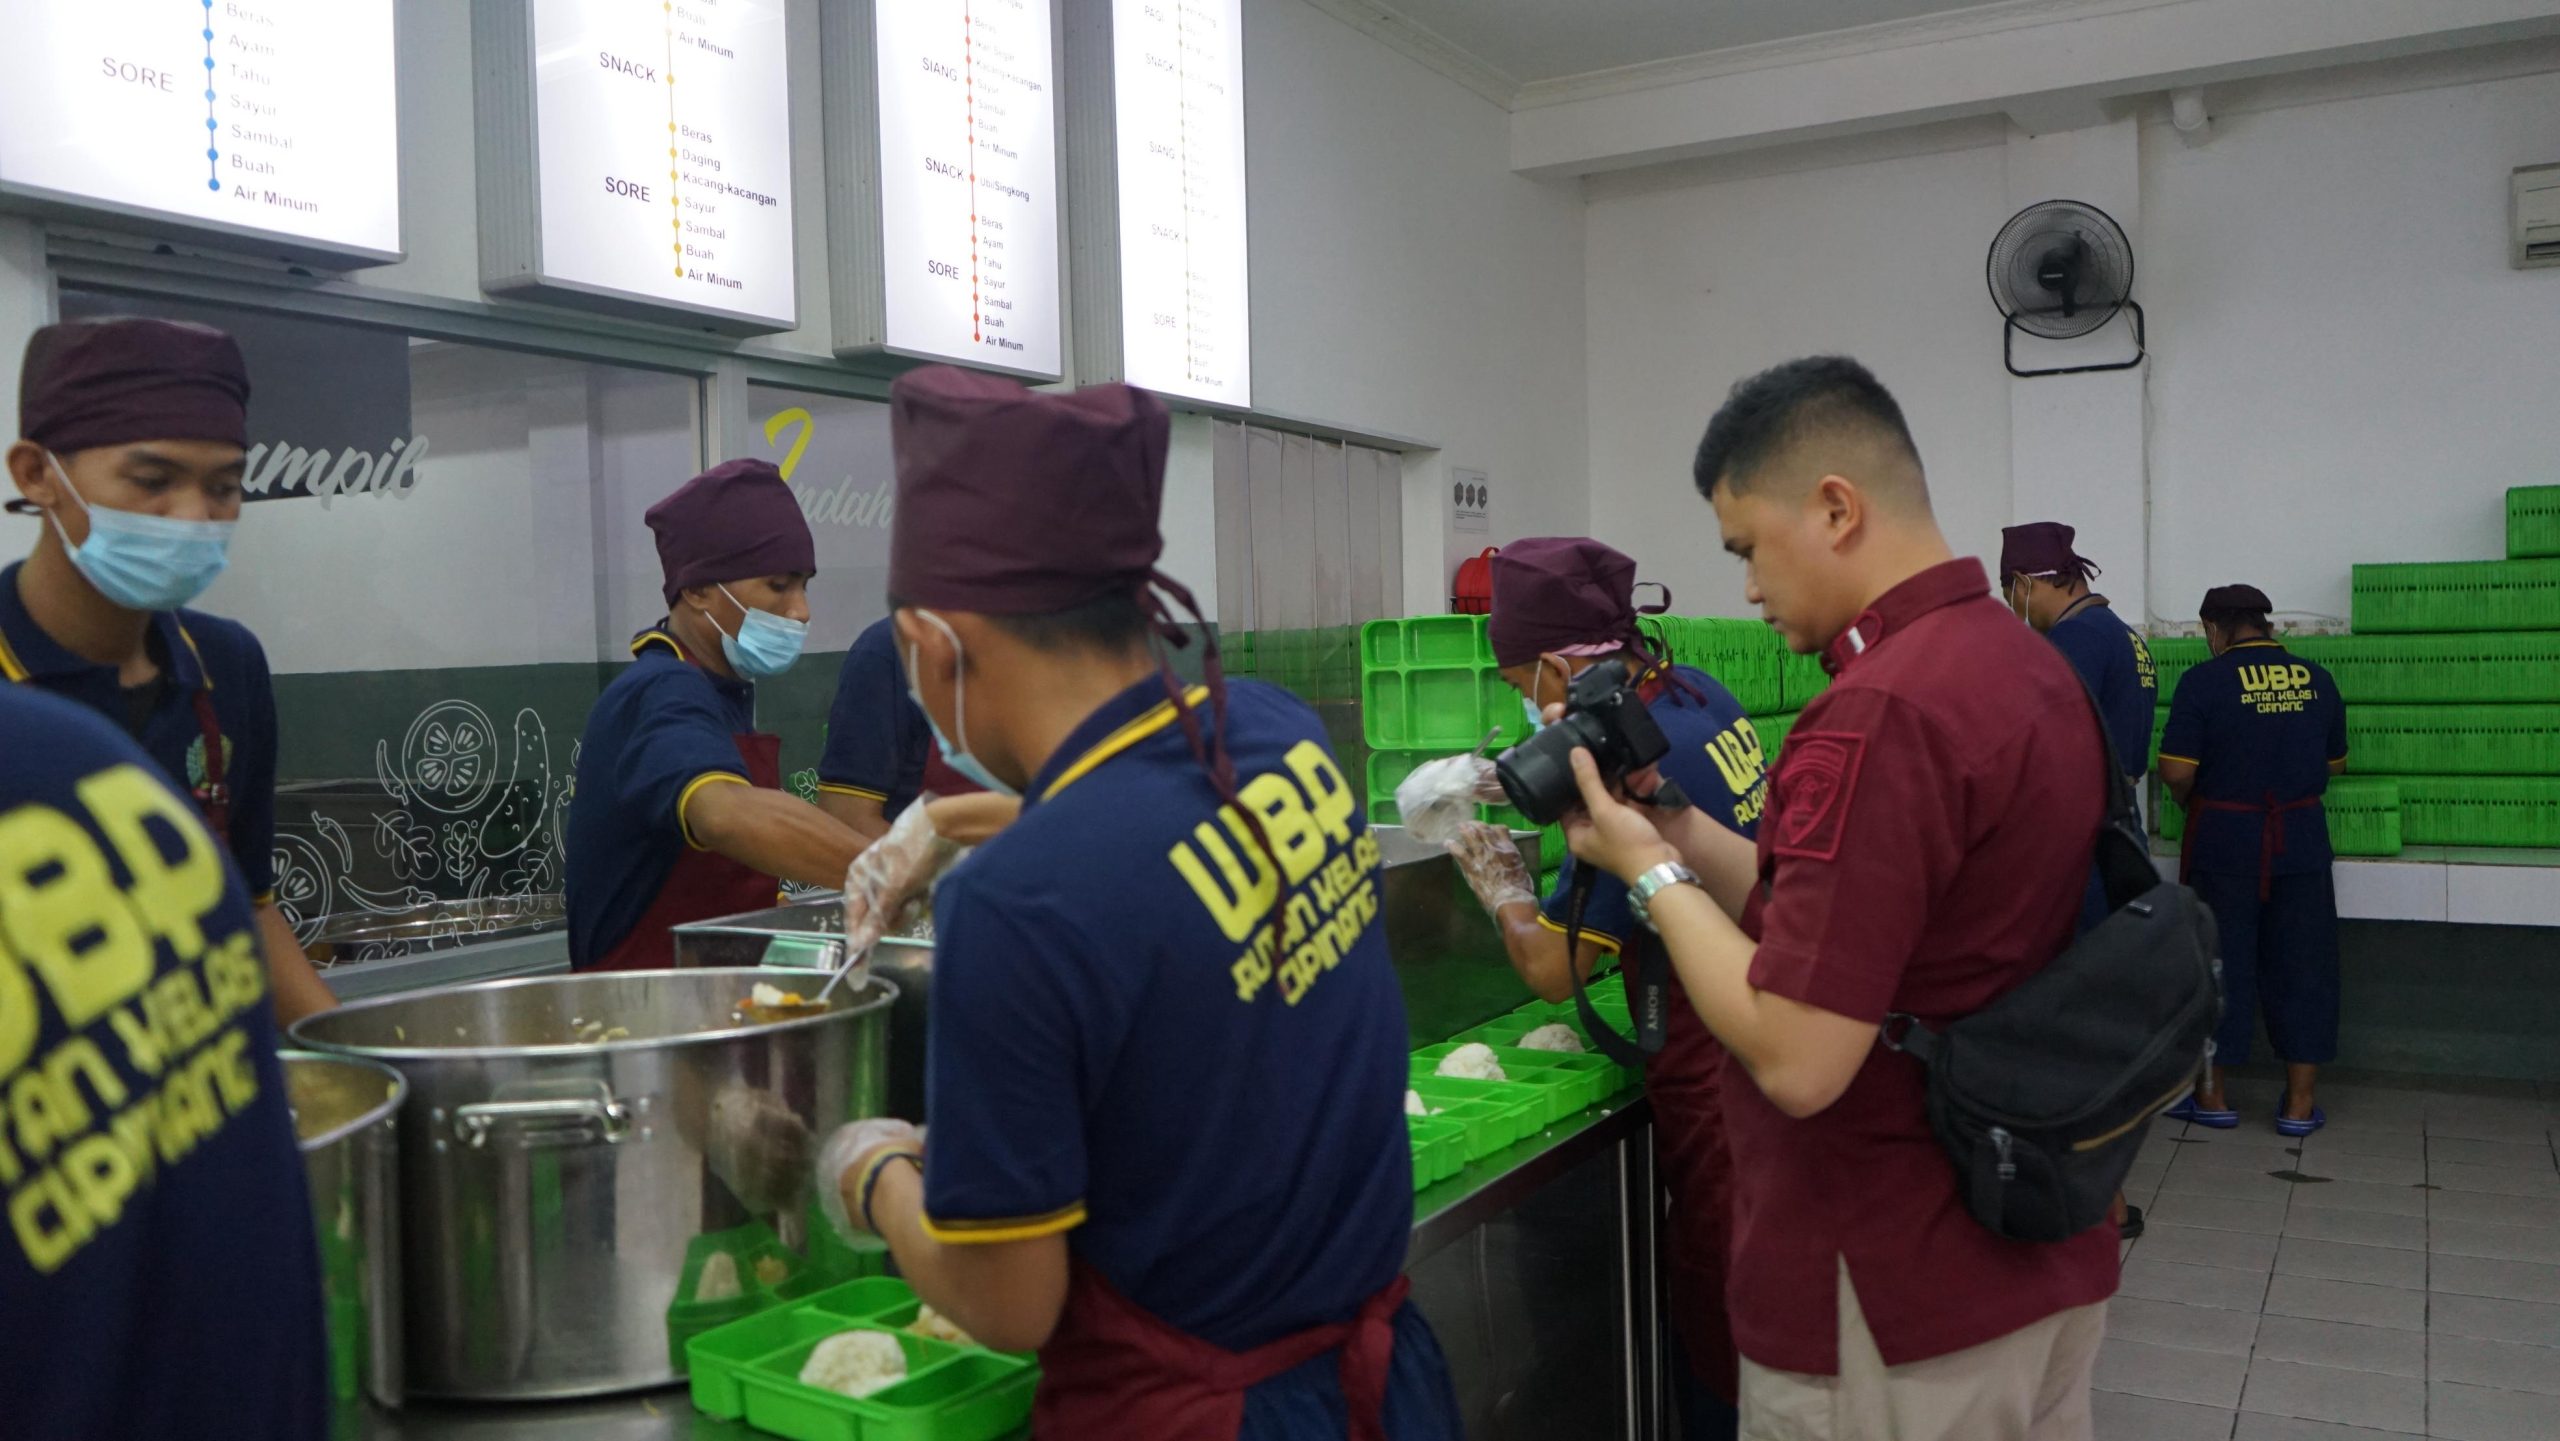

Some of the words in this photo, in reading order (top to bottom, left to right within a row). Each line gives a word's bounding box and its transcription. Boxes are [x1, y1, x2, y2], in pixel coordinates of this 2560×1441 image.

[229, 34, 275, 56] Ayam
[679, 32, 694, 45] Air
[698, 37, 734, 59] Minum
[102, 56, 174, 93] SORE
[230, 63, 271, 86] Tahu
[600, 51, 656, 83] SNACK
[922, 57, 958, 82] SIANG
[231, 123, 293, 149] Sambal
[681, 125, 712, 144] Beras
[682, 148, 721, 172] Daging
[979, 139, 990, 150] Air
[992, 143, 1018, 160] Minum
[1150, 141, 1175, 160] SIANG
[231, 153, 275, 175] Buah
[925, 156, 965, 181] SNACK
[234, 185, 258, 201] Air
[263, 190, 318, 213] Minum
[605, 176, 651, 203] SORE
[683, 171, 777, 207] Kacang-kacangan
[684, 196, 716, 214] Sayur
[685, 220, 725, 240] Sambal
[981, 216, 1003, 230] Beras
[1152, 223, 1180, 242] SNACK
[686, 244, 714, 261] Buah
[983, 236, 1004, 250] Ayam
[928, 260, 959, 280] SORE
[984, 257, 1002, 270] Tahu
[688, 268, 703, 281] Air
[707, 272, 743, 290] Minum
[984, 276, 1006, 290] Sayur
[984, 296, 1012, 310] Sambal
[984, 315, 1004, 328] Buah
[1154, 312, 1176, 328] SORE
[986, 336, 997, 347] Air
[999, 338, 1024, 352] Minum
[241, 434, 429, 511] ampil
[2238, 664, 2311, 692] WBP
[2241, 691, 2275, 704] RUTAN
[2278, 690, 2312, 701] KELAS
[2257, 701, 2304, 713] CIPINANG
[1168, 740, 1355, 943] WBP
[1648, 984, 1659, 1031] SONY
